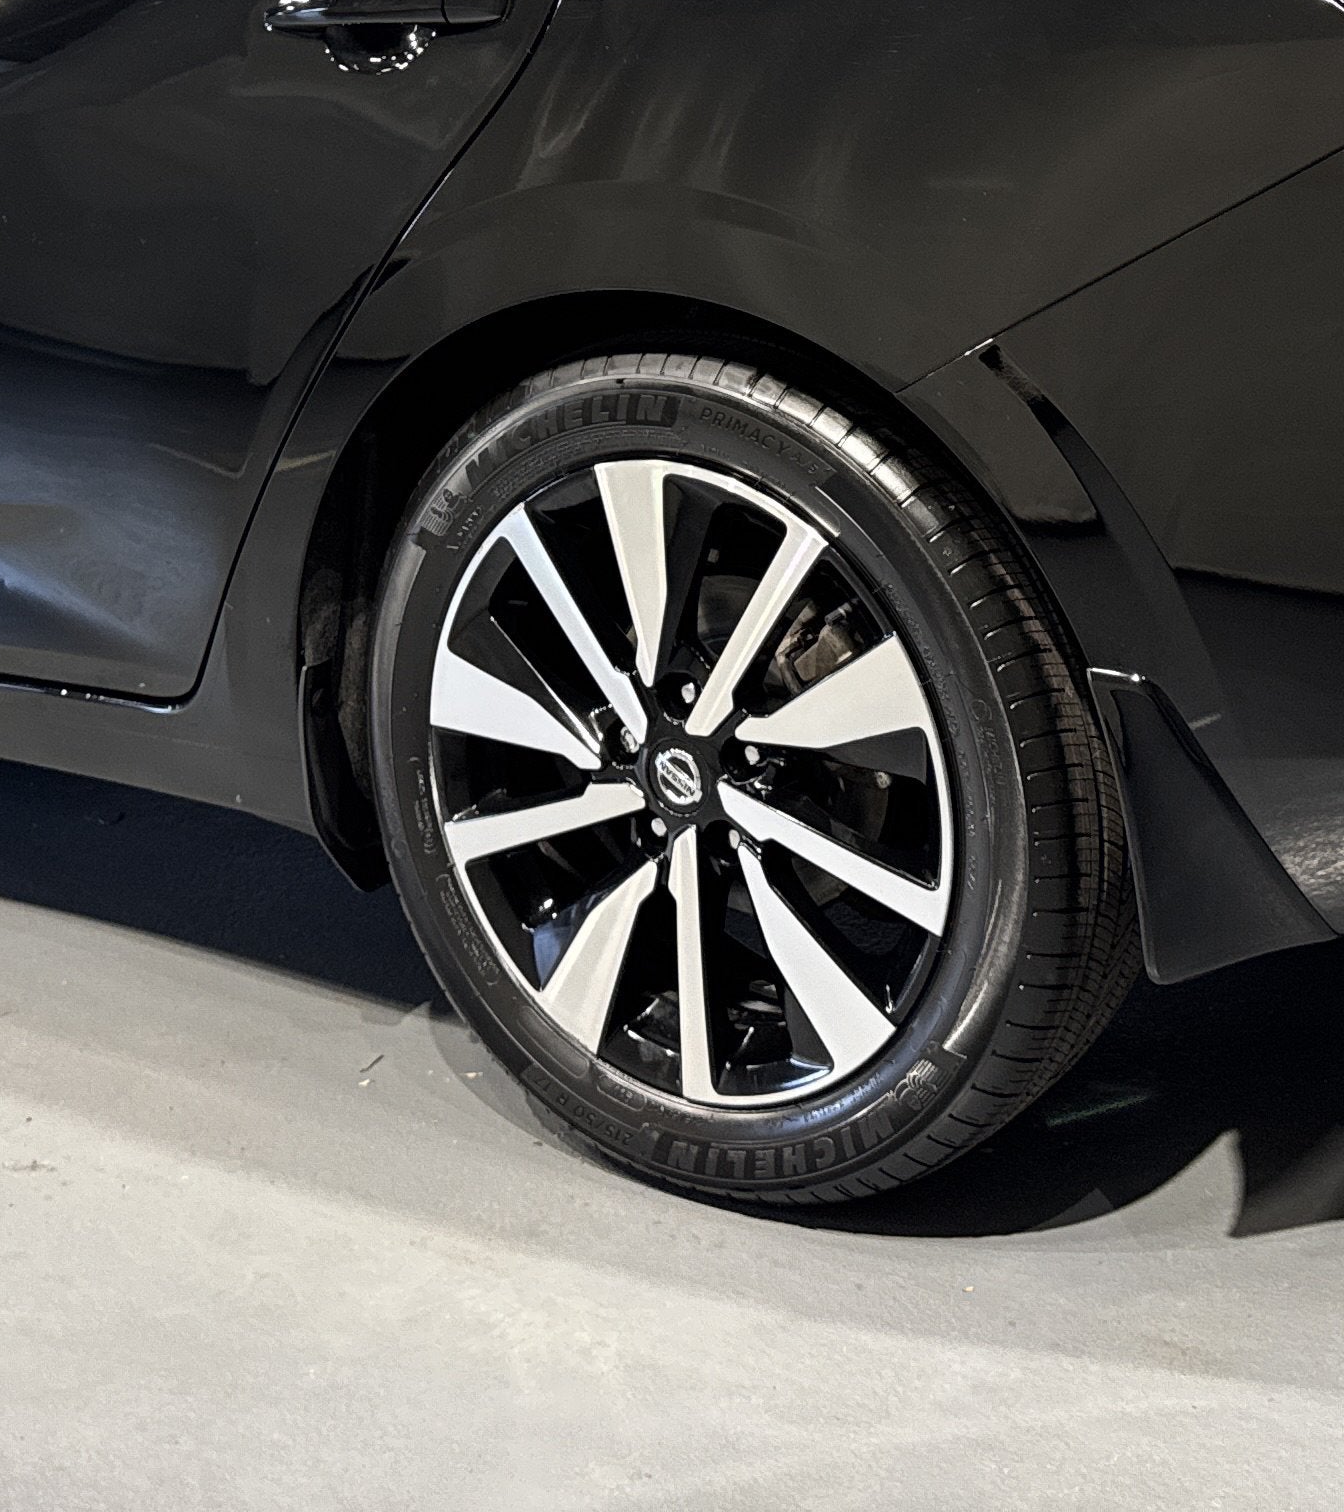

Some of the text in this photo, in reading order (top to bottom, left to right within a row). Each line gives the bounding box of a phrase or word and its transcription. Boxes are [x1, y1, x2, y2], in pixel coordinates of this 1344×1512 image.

[465, 394, 667, 487] MICHELIN
[699, 407, 791, 456] PRIMACY
[574, 1105, 634, 1145] 215/50
[667, 1115, 895, 1178] MICHELIN
